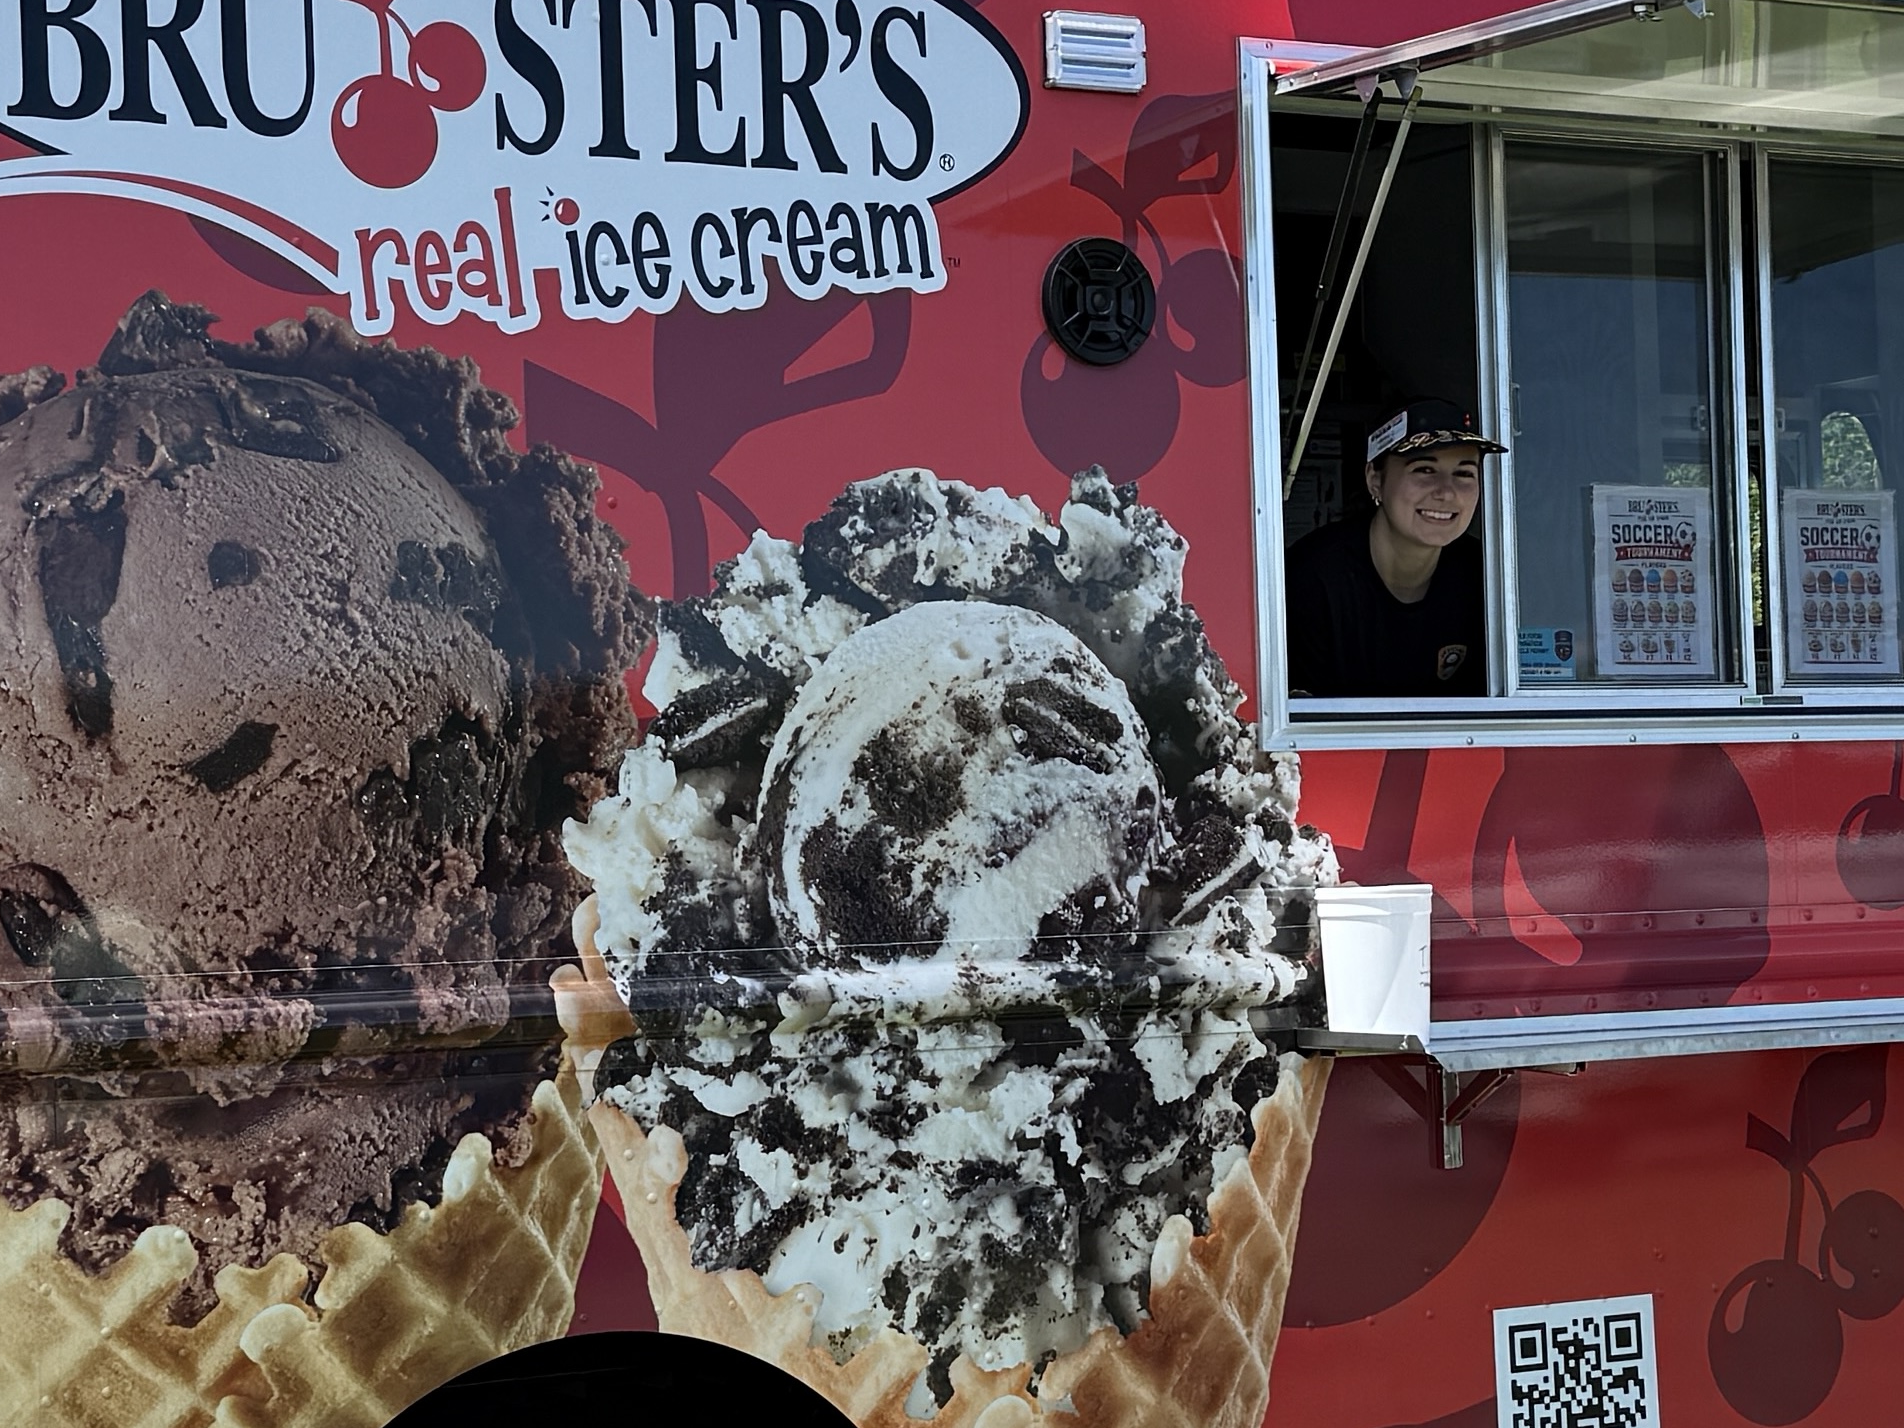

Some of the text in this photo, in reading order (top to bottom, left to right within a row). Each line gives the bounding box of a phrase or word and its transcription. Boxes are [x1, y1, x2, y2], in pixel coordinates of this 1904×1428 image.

[355, 187, 933, 320] real ice cream
[1611, 524, 1674, 545] SOCCER
[1800, 526, 1859, 546] SOCCER
